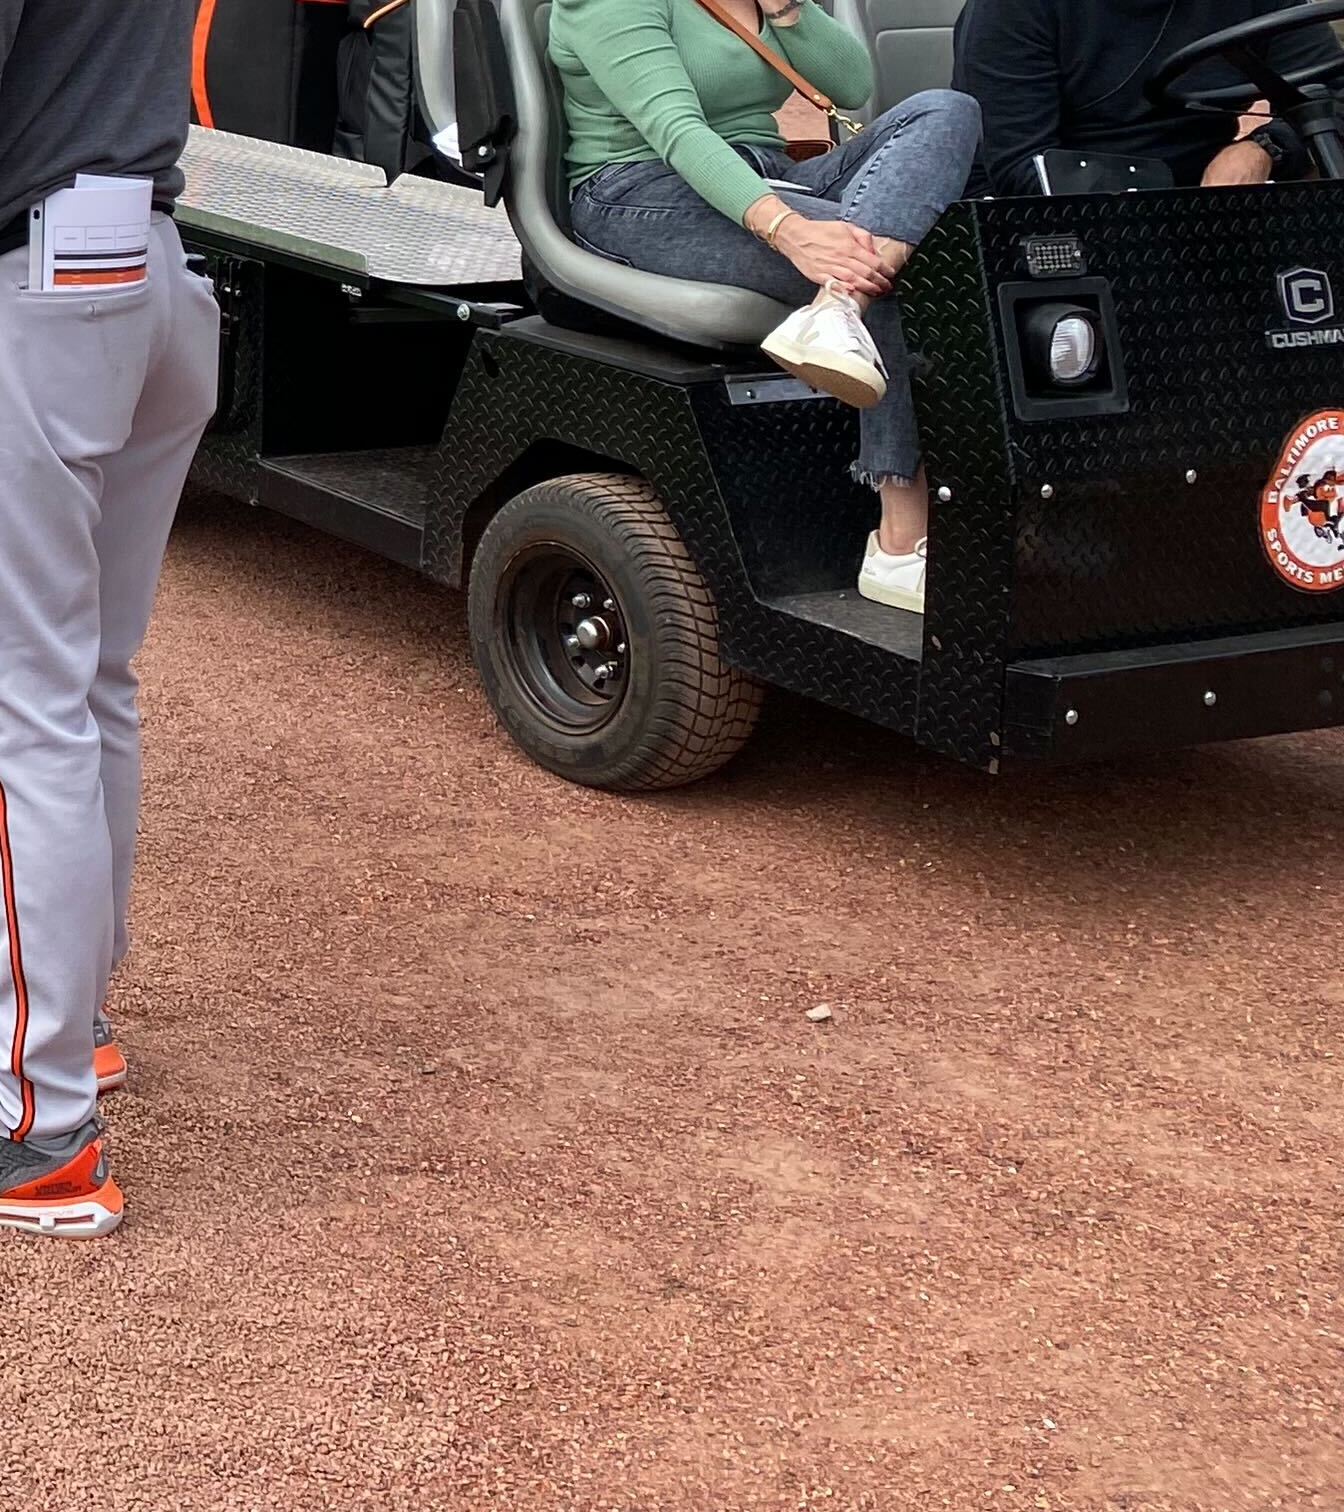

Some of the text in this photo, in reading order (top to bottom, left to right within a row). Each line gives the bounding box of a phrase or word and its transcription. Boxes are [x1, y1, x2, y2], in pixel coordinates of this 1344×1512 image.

[1291, 279, 1325, 313] C
[1271, 328, 1344, 349] CUSHMA
[1267, 417, 1339, 504] BALTIMORE
[1266, 527, 1344, 585] SPORTS ME
